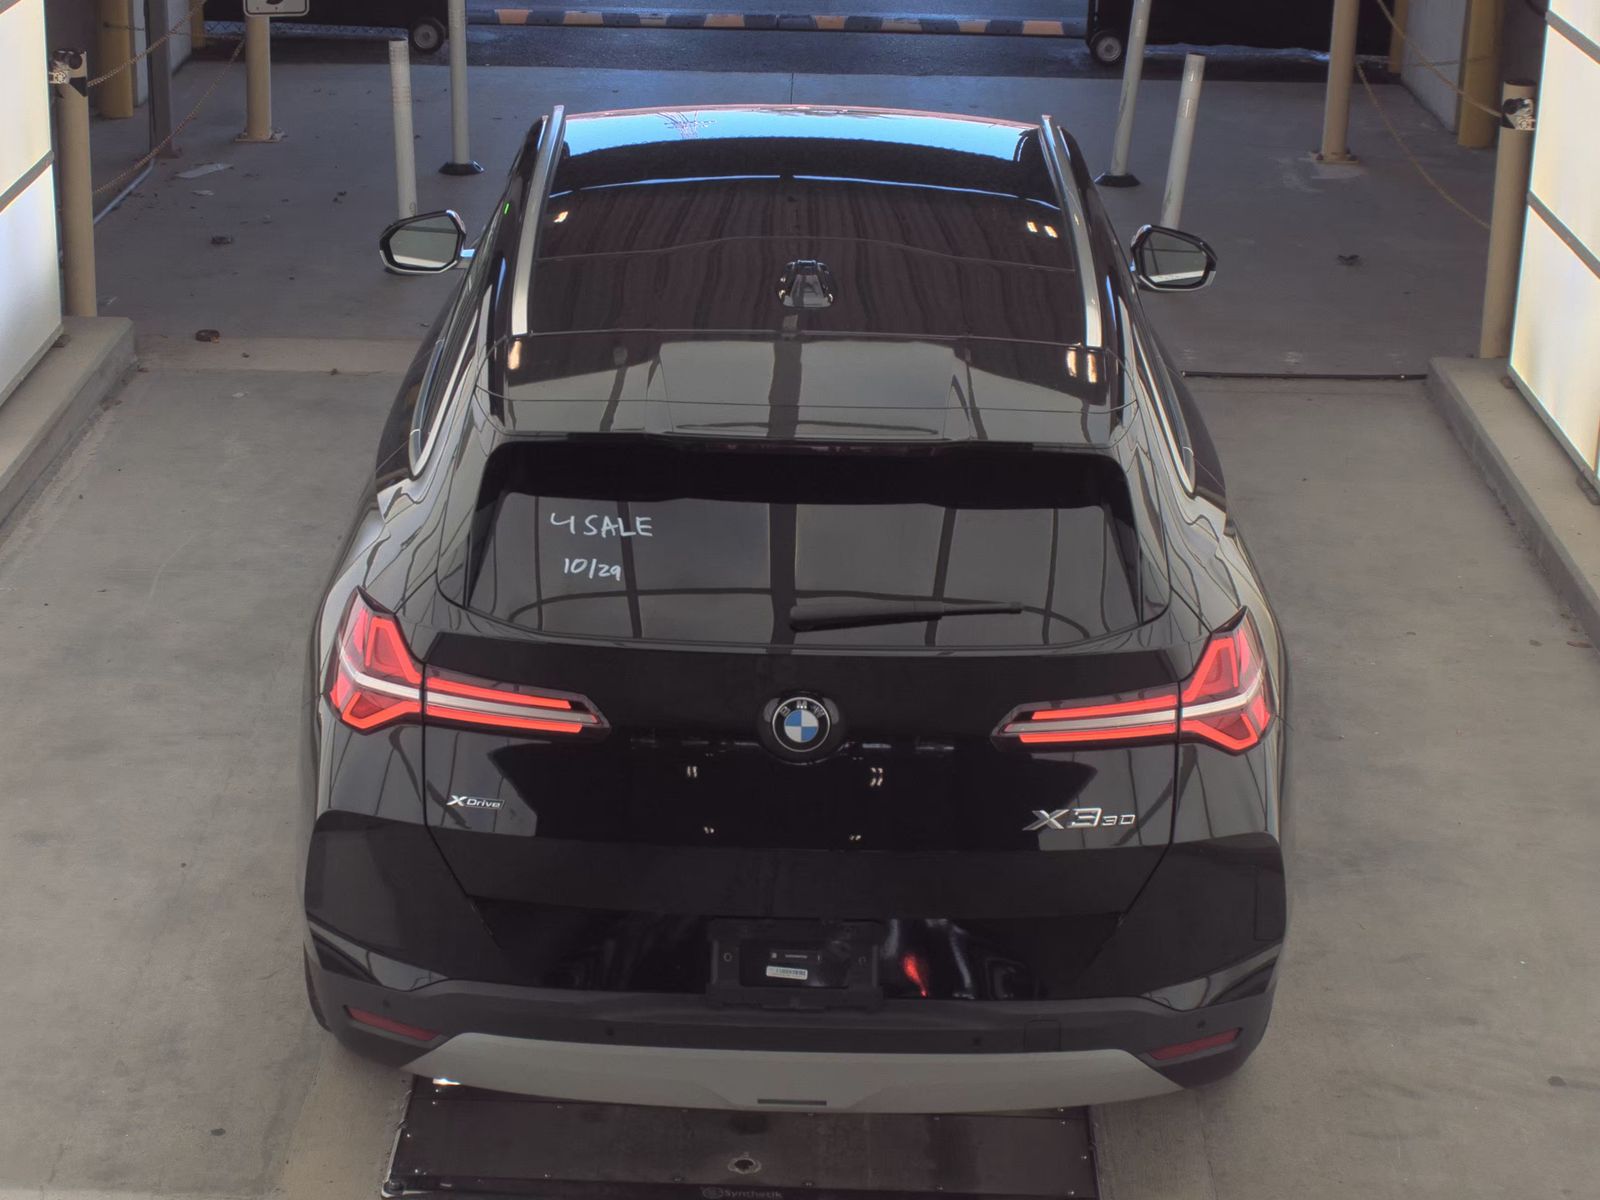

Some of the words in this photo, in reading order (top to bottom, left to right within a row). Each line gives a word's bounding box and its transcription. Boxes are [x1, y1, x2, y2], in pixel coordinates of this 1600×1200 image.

[550, 512, 576, 535] 4
[583, 514, 653, 538] SALE
[564, 558, 622, 582] 10/29
